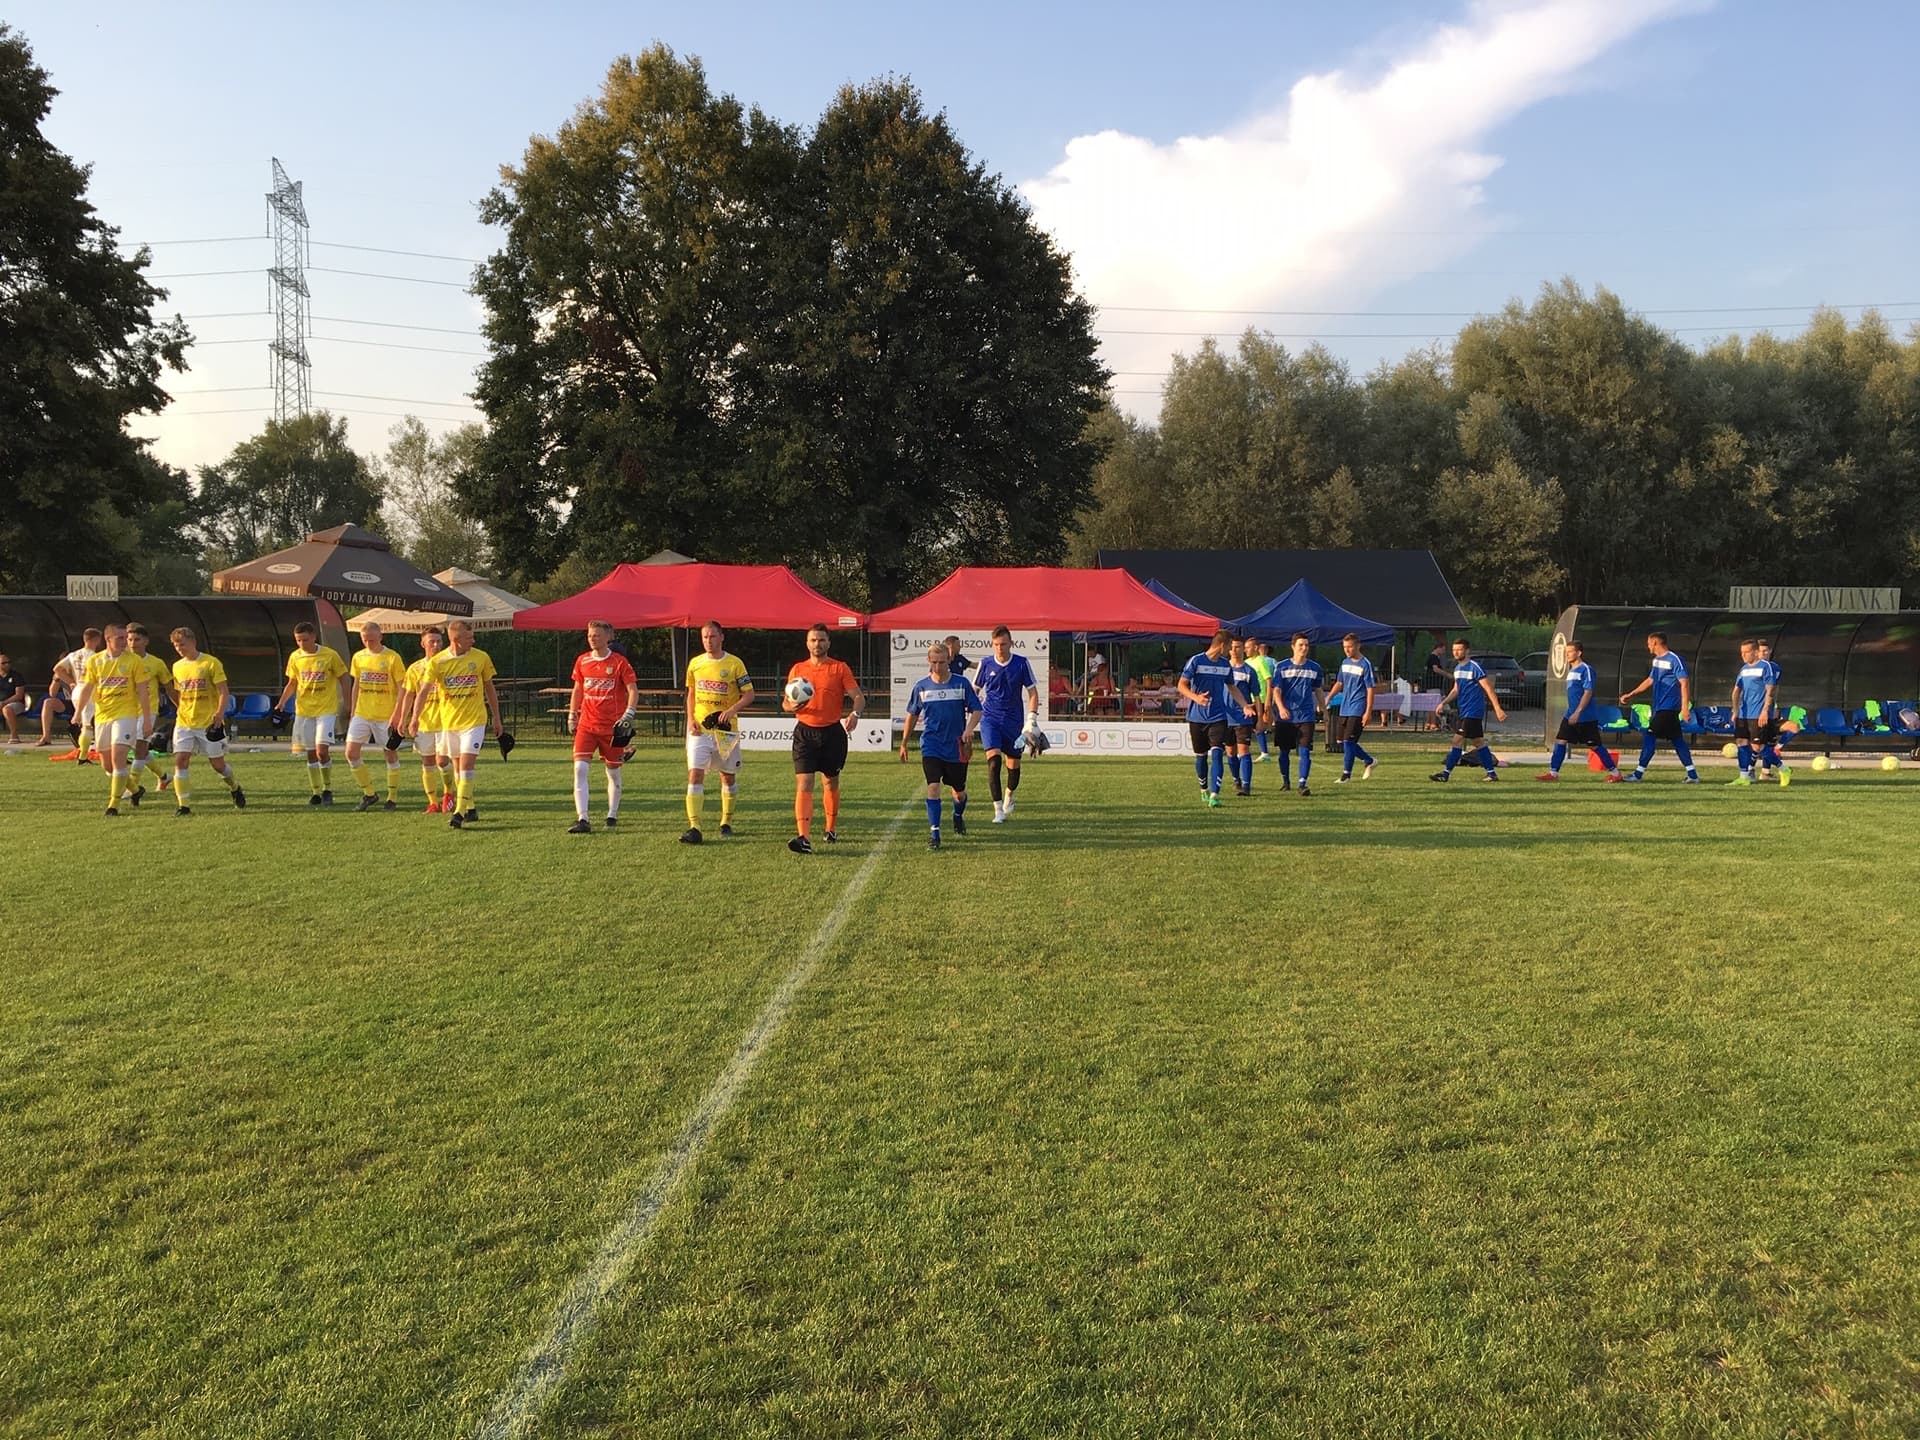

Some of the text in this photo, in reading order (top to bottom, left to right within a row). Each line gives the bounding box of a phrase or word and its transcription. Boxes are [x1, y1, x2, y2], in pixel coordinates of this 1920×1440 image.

[70, 577, 116, 597] GOŚCIE
[230, 580, 301, 597] LODY JAK DAWNIEJ
[347, 593, 365, 604] JAK
[367, 594, 407, 608] DAWNIEJ
[1733, 587, 1896, 610] RADZISZOWIANKA
[914, 639, 932, 649] LKS
